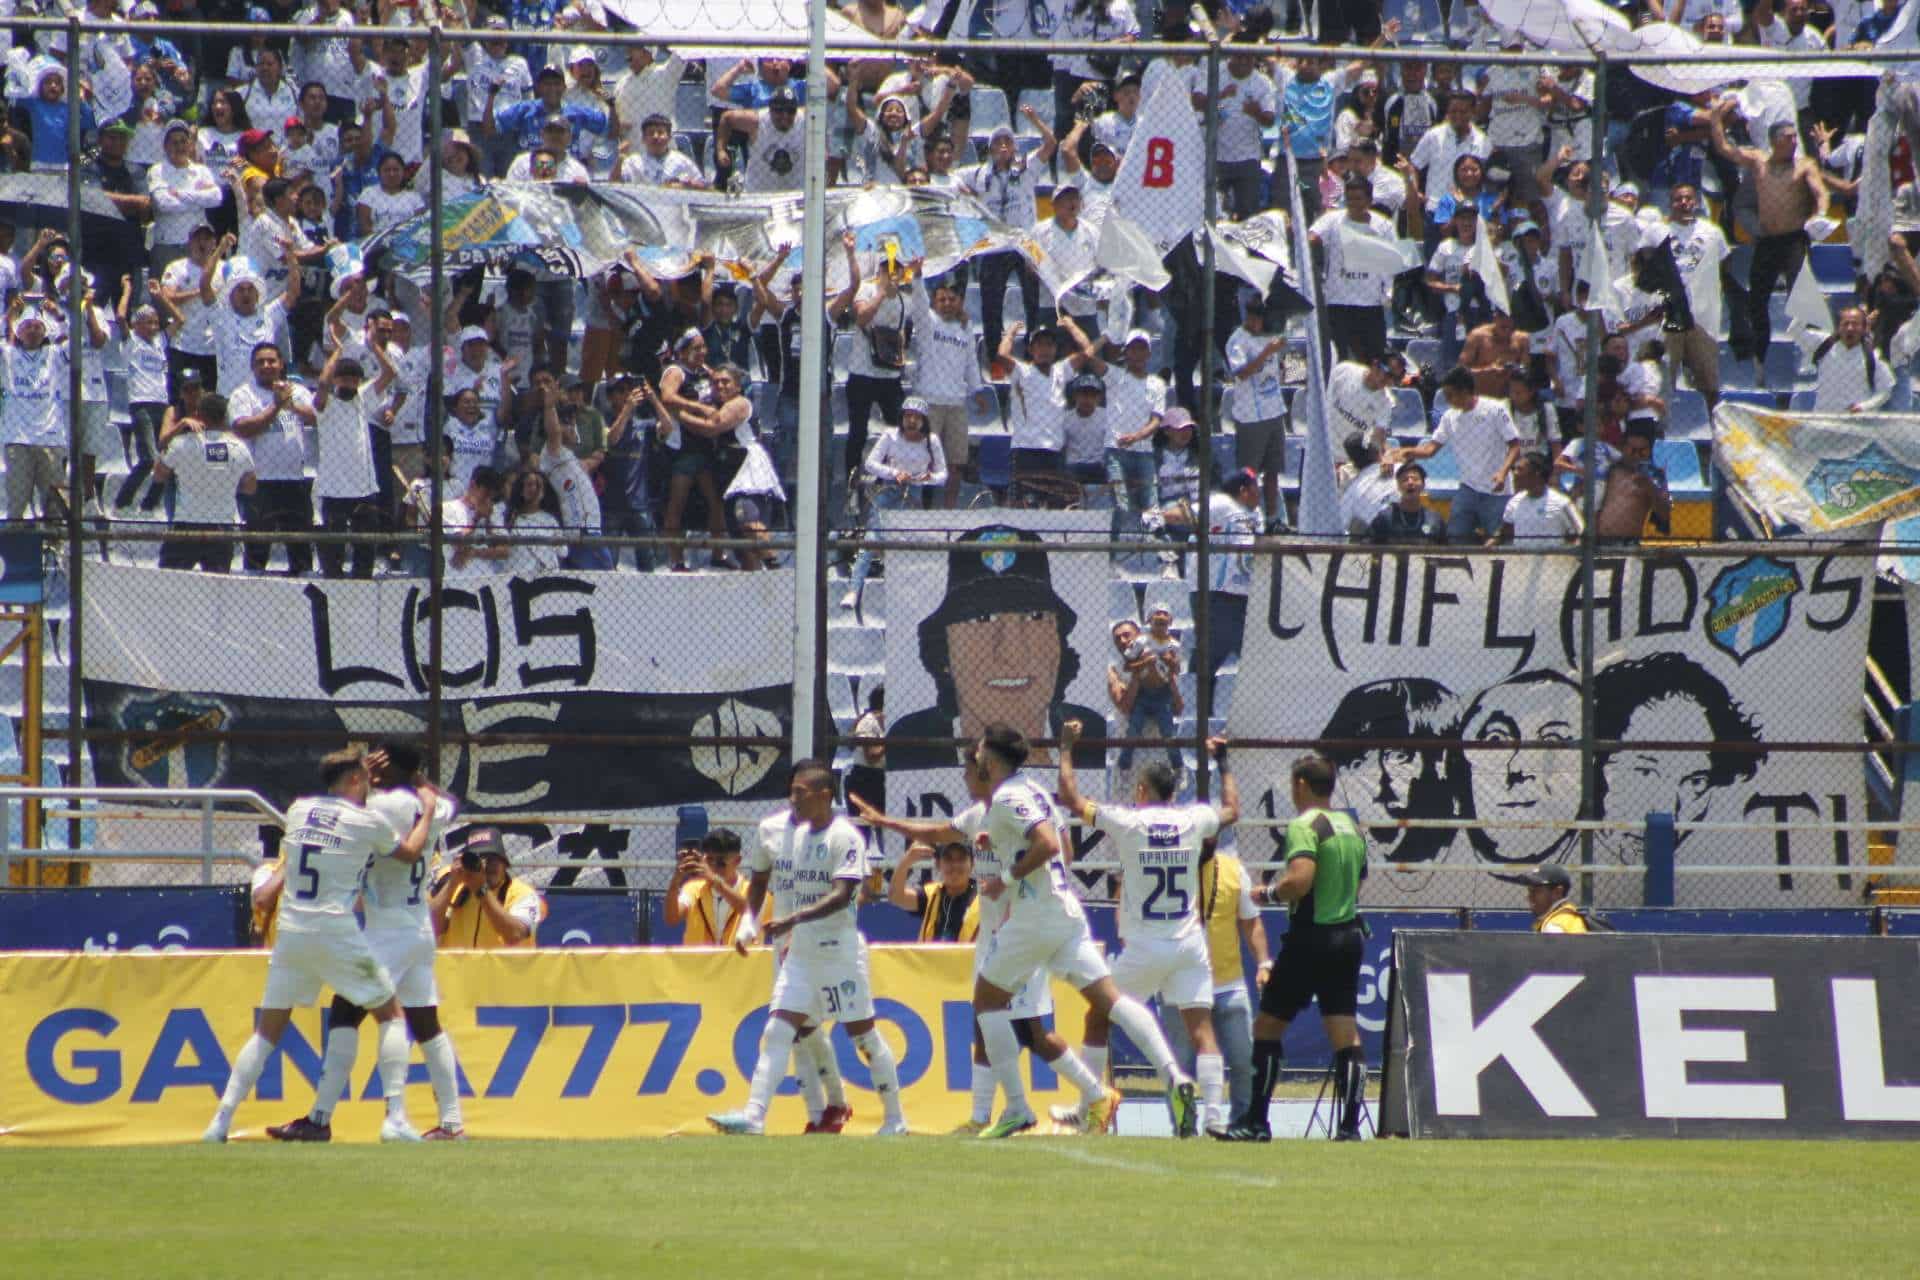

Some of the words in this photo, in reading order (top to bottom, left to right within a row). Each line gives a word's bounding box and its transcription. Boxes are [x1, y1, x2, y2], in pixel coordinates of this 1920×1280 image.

[1142, 137, 1174, 189] B
[303, 575, 597, 697] LOS
[296, 843, 321, 899] 5
[1142, 865, 1190, 921] 25
[821, 986, 841, 1014] 31
[1426, 973, 1920, 1121] KEL
